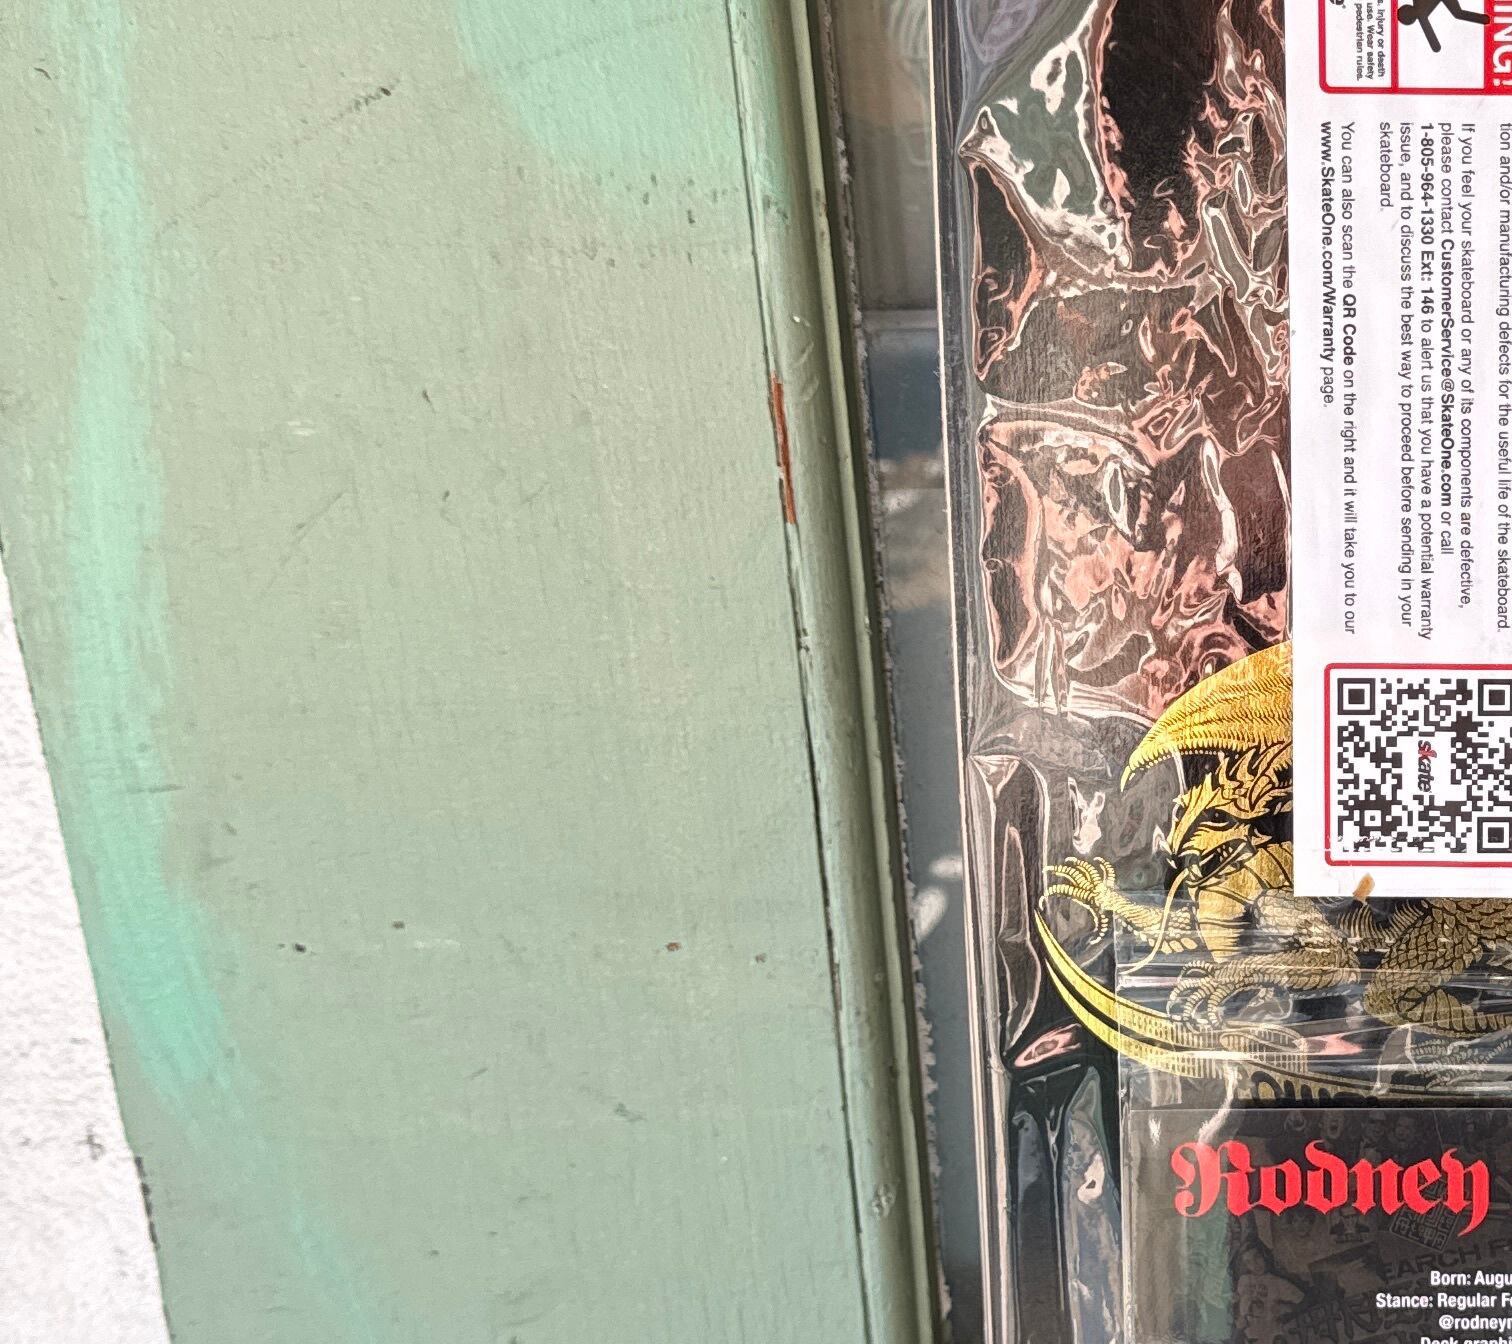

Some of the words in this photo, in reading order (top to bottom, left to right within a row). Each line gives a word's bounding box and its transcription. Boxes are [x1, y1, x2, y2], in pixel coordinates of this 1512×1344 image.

[1374, 8, 1385, 36] Injury
[1376, 37, 1384, 49] or
[1376, 50, 1385, 77] death
[1437, 122, 1454, 174] please
[1419, 122, 1435, 245] 1-805-964-1330
[1439, 178, 1454, 234] contact
[1316, 120, 1337, 362] www.SkateOne.com/Warranty
[1420, 250, 1434, 282] Ext:
[1419, 286, 1435, 315] 146
[1419, 318, 1433, 333] to
[1419, 337, 1434, 371] alert
[1318, 366, 1334, 407] page.
[1420, 374, 1431, 393] us
[1439, 238, 1455, 507] CustomerService@SkateOne.com
[1419, 396, 1434, 425] that
[1416, 428, 1431, 455] you
[1419, 459, 1434, 495] have
[1420, 499, 1431, 509] a
[1439, 510, 1451, 527] or
[1416, 512, 1435, 574] potential
[1439, 530, 1454, 555] call
[1416, 577, 1433, 640] warranty
[1171, 1139, 1490, 1236] Rodney
[1429, 1270, 1471, 1286] Born:
[1375, 1292, 1434, 1309] Stance:
[1436, 1292, 1498, 1311] Regular
